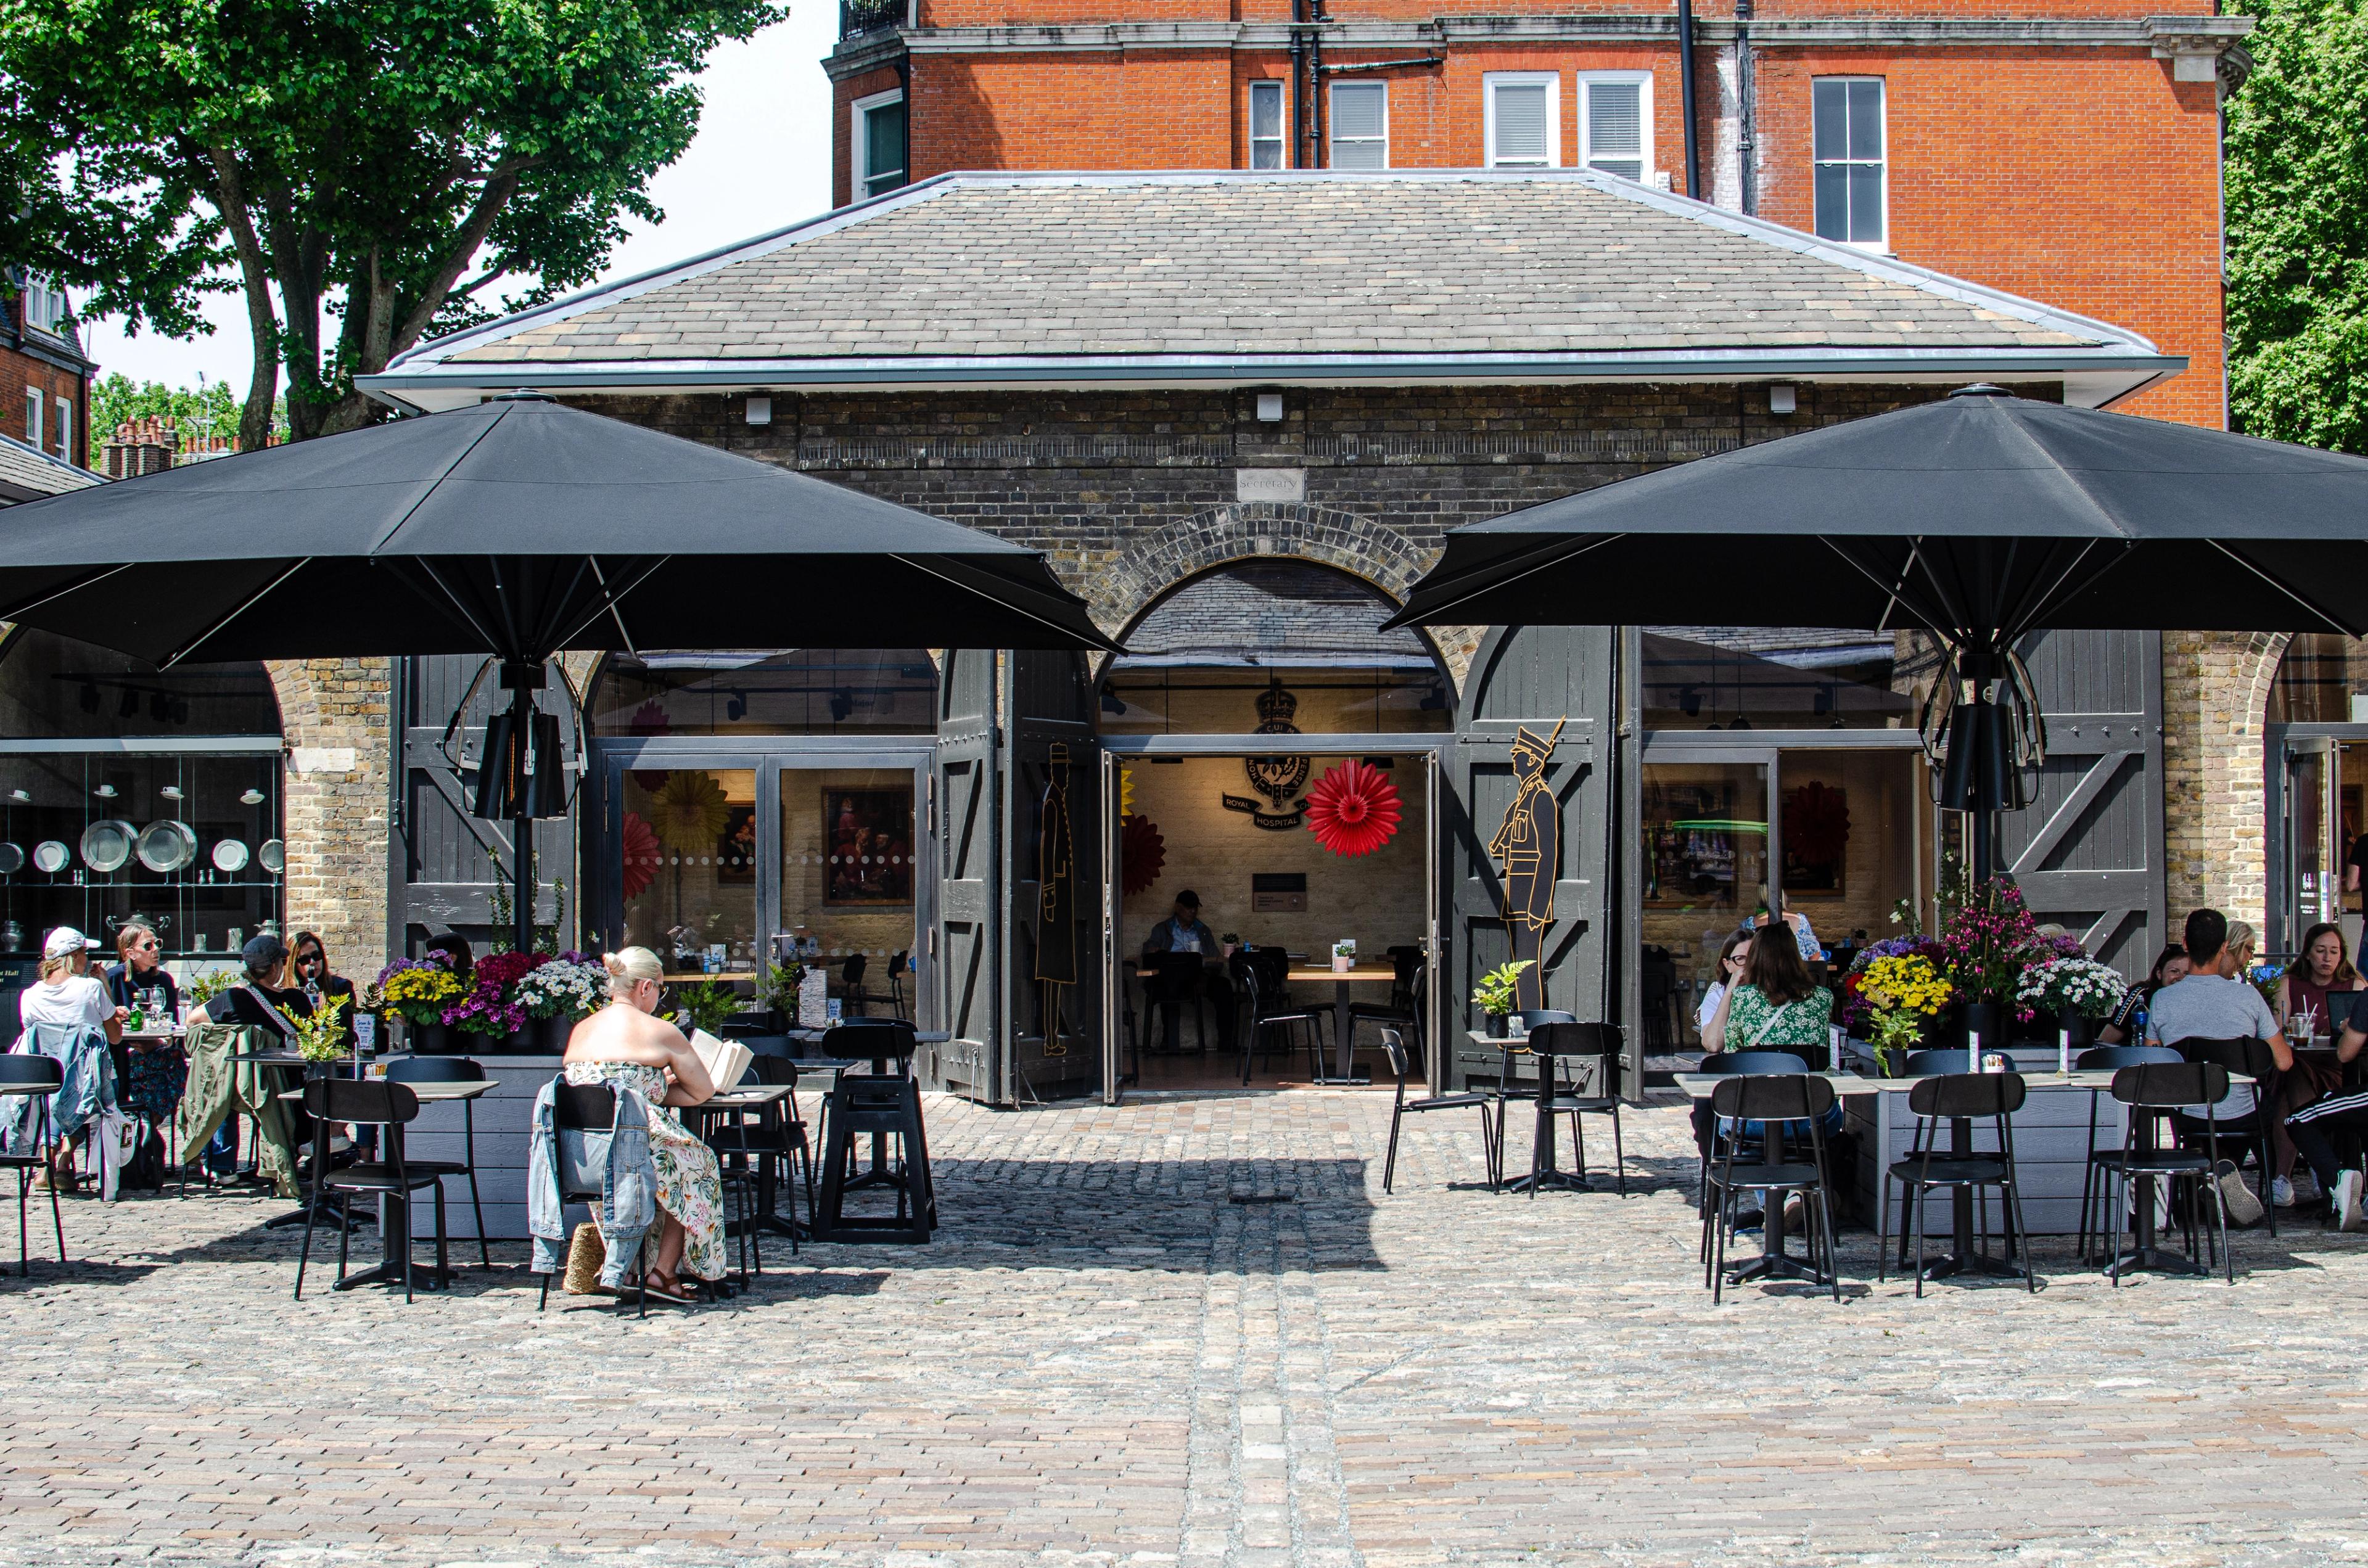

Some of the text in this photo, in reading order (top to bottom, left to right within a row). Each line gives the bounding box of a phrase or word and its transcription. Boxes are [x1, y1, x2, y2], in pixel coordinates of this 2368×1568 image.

[1240, 479, 1297, 490] Secretary
[1293, 759, 1307, 786] PENSE
[1226, 799, 1297, 827] ROYAL HOSPITAL
[120, 1123, 132, 1147] C
